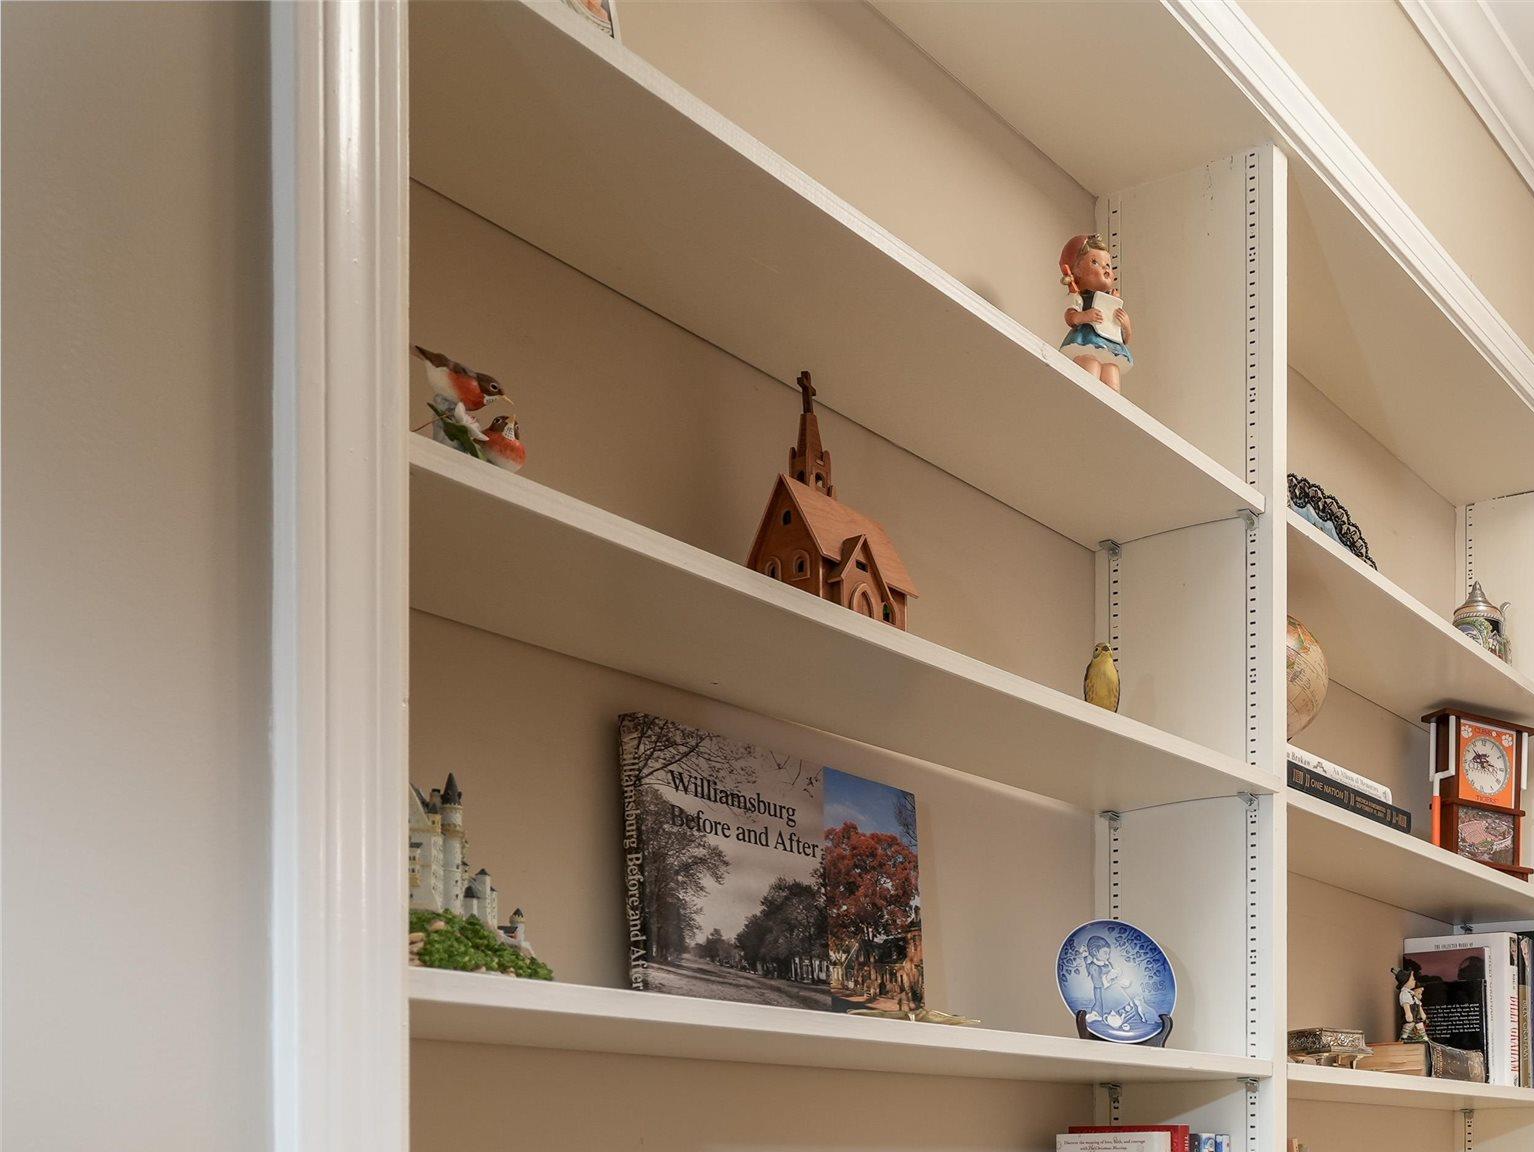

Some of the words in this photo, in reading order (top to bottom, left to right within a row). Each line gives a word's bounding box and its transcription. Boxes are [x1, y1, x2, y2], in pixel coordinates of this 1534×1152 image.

[620, 730, 641, 849] Williamsburg
[668, 769, 797, 828] Williamsburg
[1311, 780, 1324, 791] ONE
[1324, 786, 1344, 800] NATION
[668, 805, 731, 840] Before
[736, 825, 769, 847] and
[773, 831, 819, 859] After
[627, 852, 644, 905] Before
[627, 908, 645, 941] and
[630, 944, 648, 991] After
